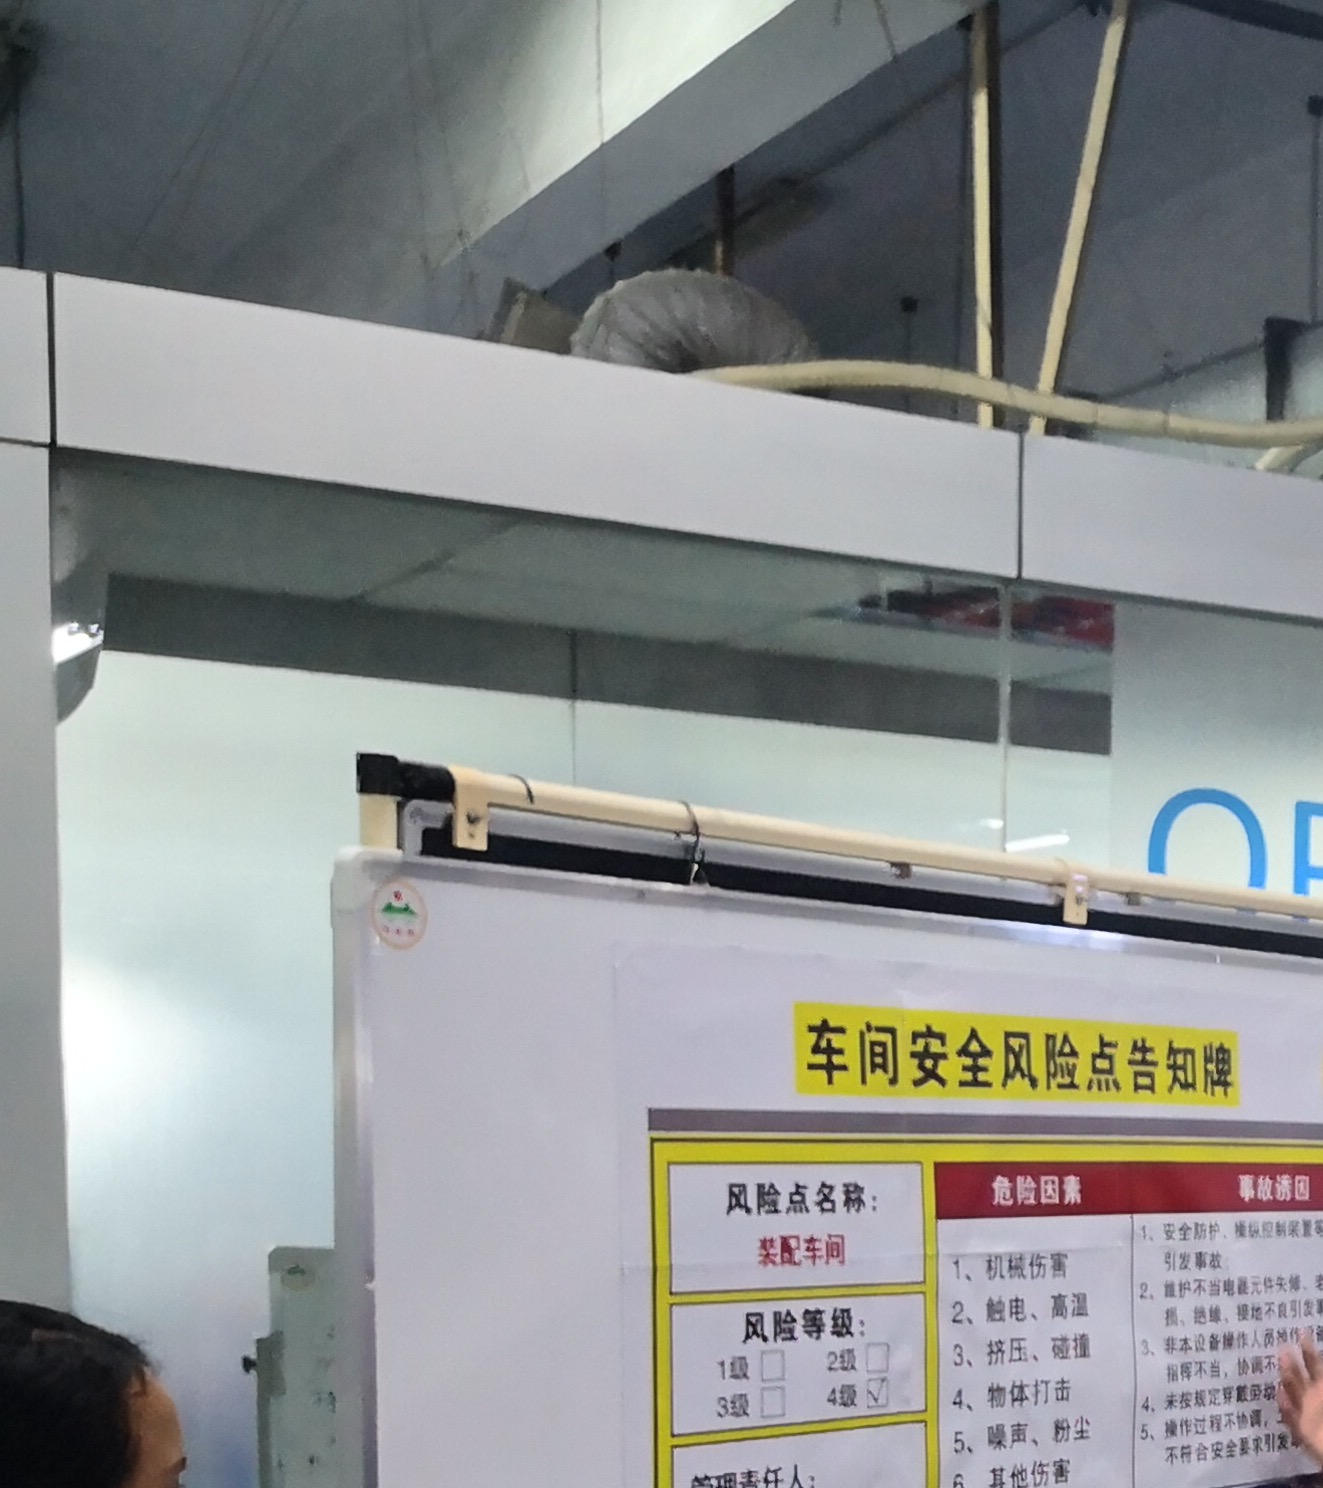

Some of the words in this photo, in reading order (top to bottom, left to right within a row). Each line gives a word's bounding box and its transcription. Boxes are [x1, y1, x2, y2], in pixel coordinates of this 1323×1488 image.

[806, 1017, 1235, 1099] 车间安全风险点告知牌
[726, 1181, 878, 1216] 风险点名称：
[991, 1174, 1083, 1207] 危险因素
[757, 1233, 847, 1267] 装配车间
[742, 1307, 866, 1343] 风险等级：
[716, 1355, 751, 1381] 1级
[826, 1348, 858, 1373] 2级
[716, 1393, 751, 1419] 3级
[826, 1384, 858, 1409] 4级
